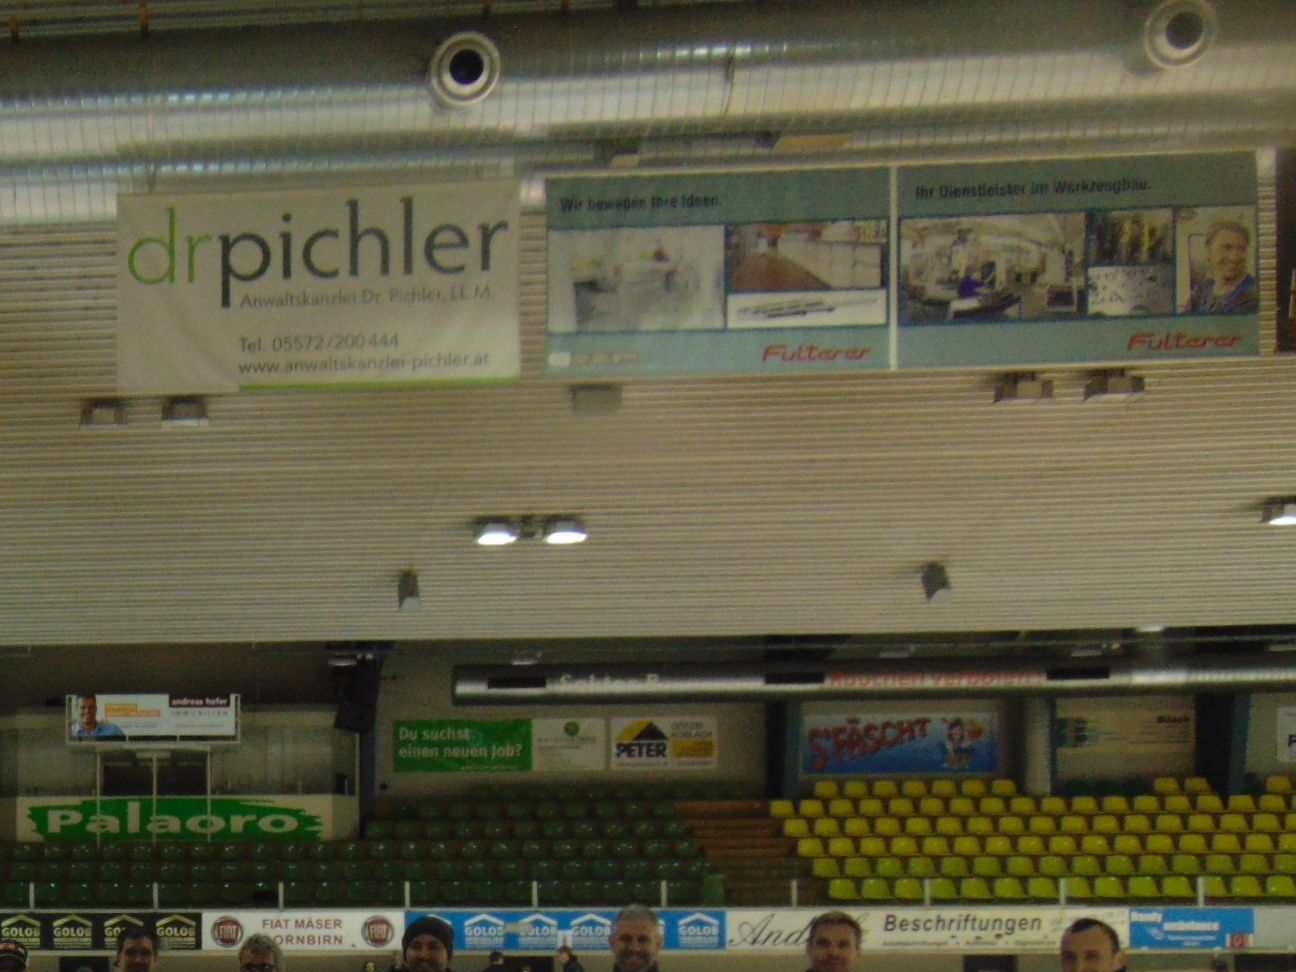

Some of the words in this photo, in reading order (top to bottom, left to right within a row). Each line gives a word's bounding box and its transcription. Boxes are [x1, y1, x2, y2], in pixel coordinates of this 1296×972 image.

[916, 184, 933, 199] Ihr
[939, 181, 1027, 199] Dienstleister
[398, 727, 419, 741] Du
[421, 725, 471, 741] suchst
[616, 742, 667, 759] PETER
[47, 800, 299, 835] Palaoro
[262, 918, 301, 930] FIAT
[883, 912, 1042, 936] Beschriftungen
[276, 935, 343, 946] ORNBIRN
